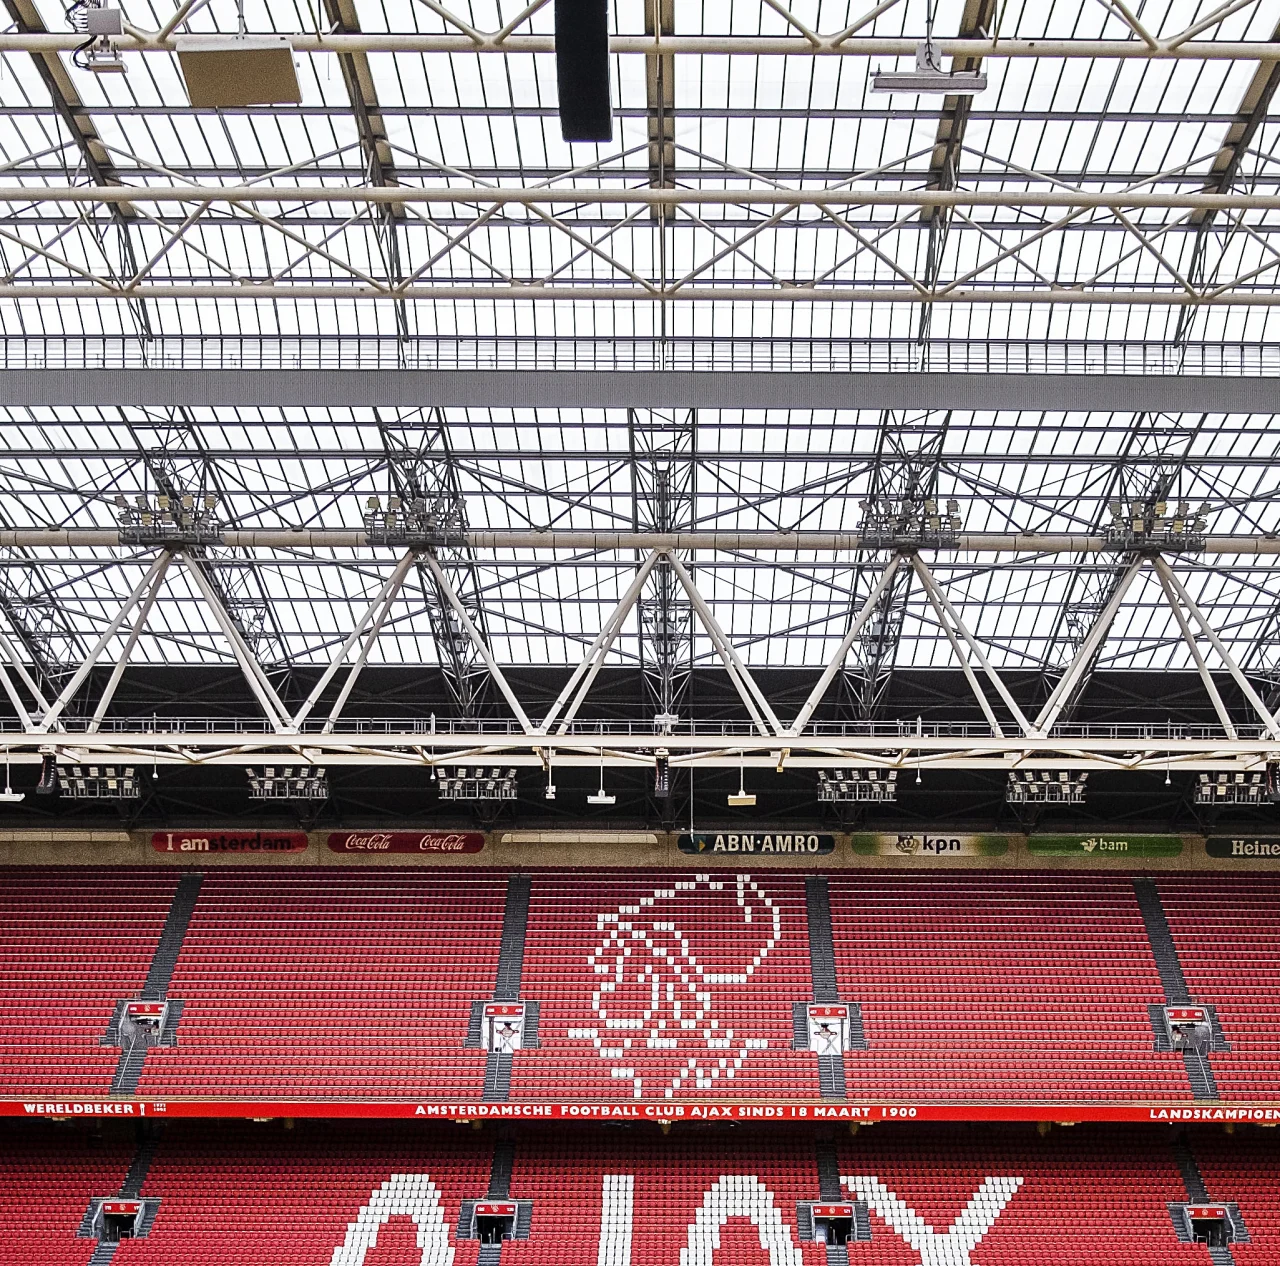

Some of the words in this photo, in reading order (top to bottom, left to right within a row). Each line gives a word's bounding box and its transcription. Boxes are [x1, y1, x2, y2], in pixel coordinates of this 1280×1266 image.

[166, 833, 174, 851] I
[922, 836, 961, 854] kpn
[1099, 837, 1128, 852] bam
[23, 1103, 134, 1114] WERELDBEKER
[415, 1105, 552, 1116] AMSTERDAMSCHE
[561, 1106, 639, 1116] FOOTBALL
[645, 1106, 685, 1117] CLUB
[691, 1106, 733, 1119] AJAX
[738, 1107, 784, 1117] SINDS
[791, 1107, 808, 1117] 18
[814, 1107, 871, 1117] MAART
[882, 1107, 917, 1118] 1900
